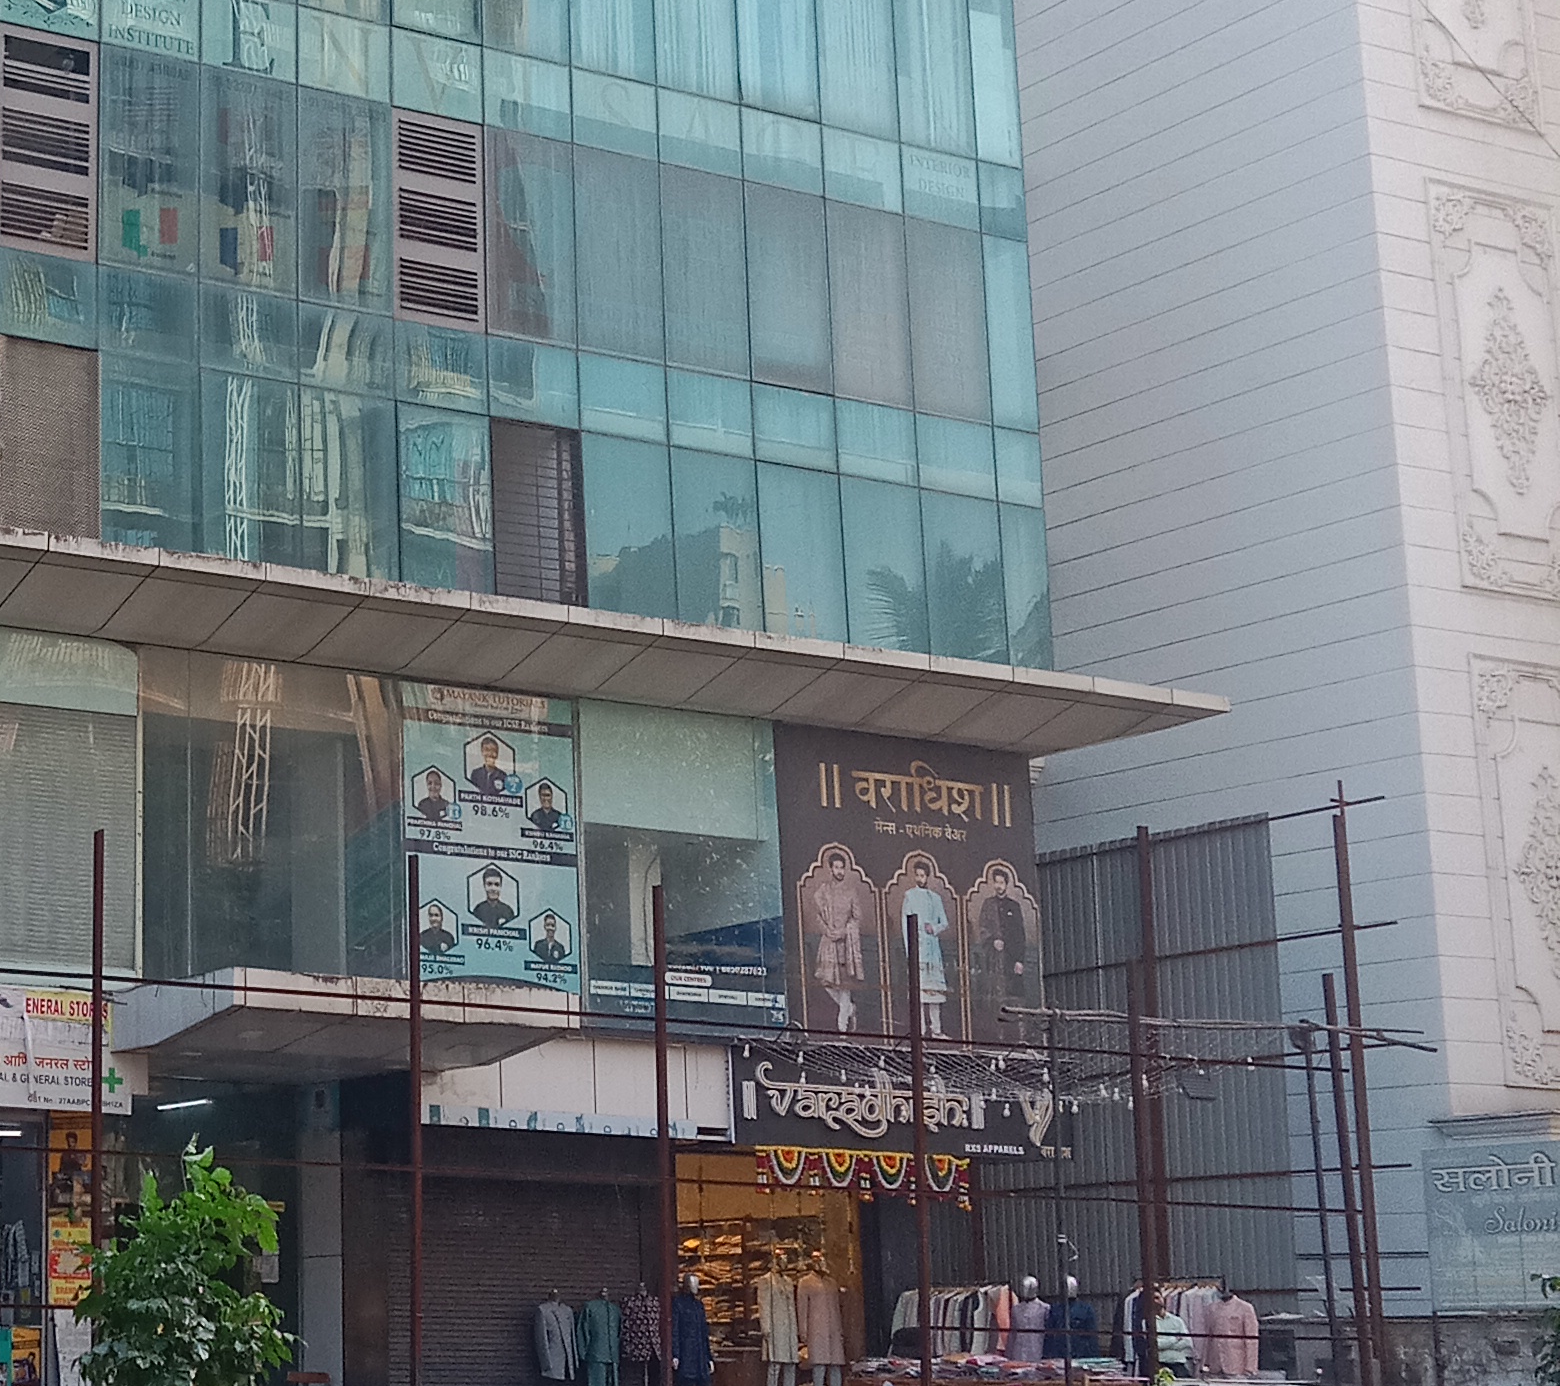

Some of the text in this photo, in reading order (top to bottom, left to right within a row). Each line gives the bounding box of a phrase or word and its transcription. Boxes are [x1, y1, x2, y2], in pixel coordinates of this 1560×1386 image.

[121, 0, 182, 27] DESIGN
[108, 24, 195, 55] INSTITUTE
[910, 154, 970, 178] INTERIOR
[919, 178, 964, 198] DESIGN
[851, 760, 984, 822] वराधिश
[472, 804, 510, 819] 98.6%
[433, 841, 488, 856] Congratulations
[476, 938, 514, 952] 96.4%
[421, 964, 453, 975] 95.0%
[536, 972, 567, 984] 94.2%
[25, 997, 109, 1021] ENERAL STORS
[34, 1056, 70, 1070] जनरल
[64, 1074, 93, 1087] STORE
[1431, 1151, 1556, 1193] सलोनी
[1484, 1205, 1559, 1234] Saloni
